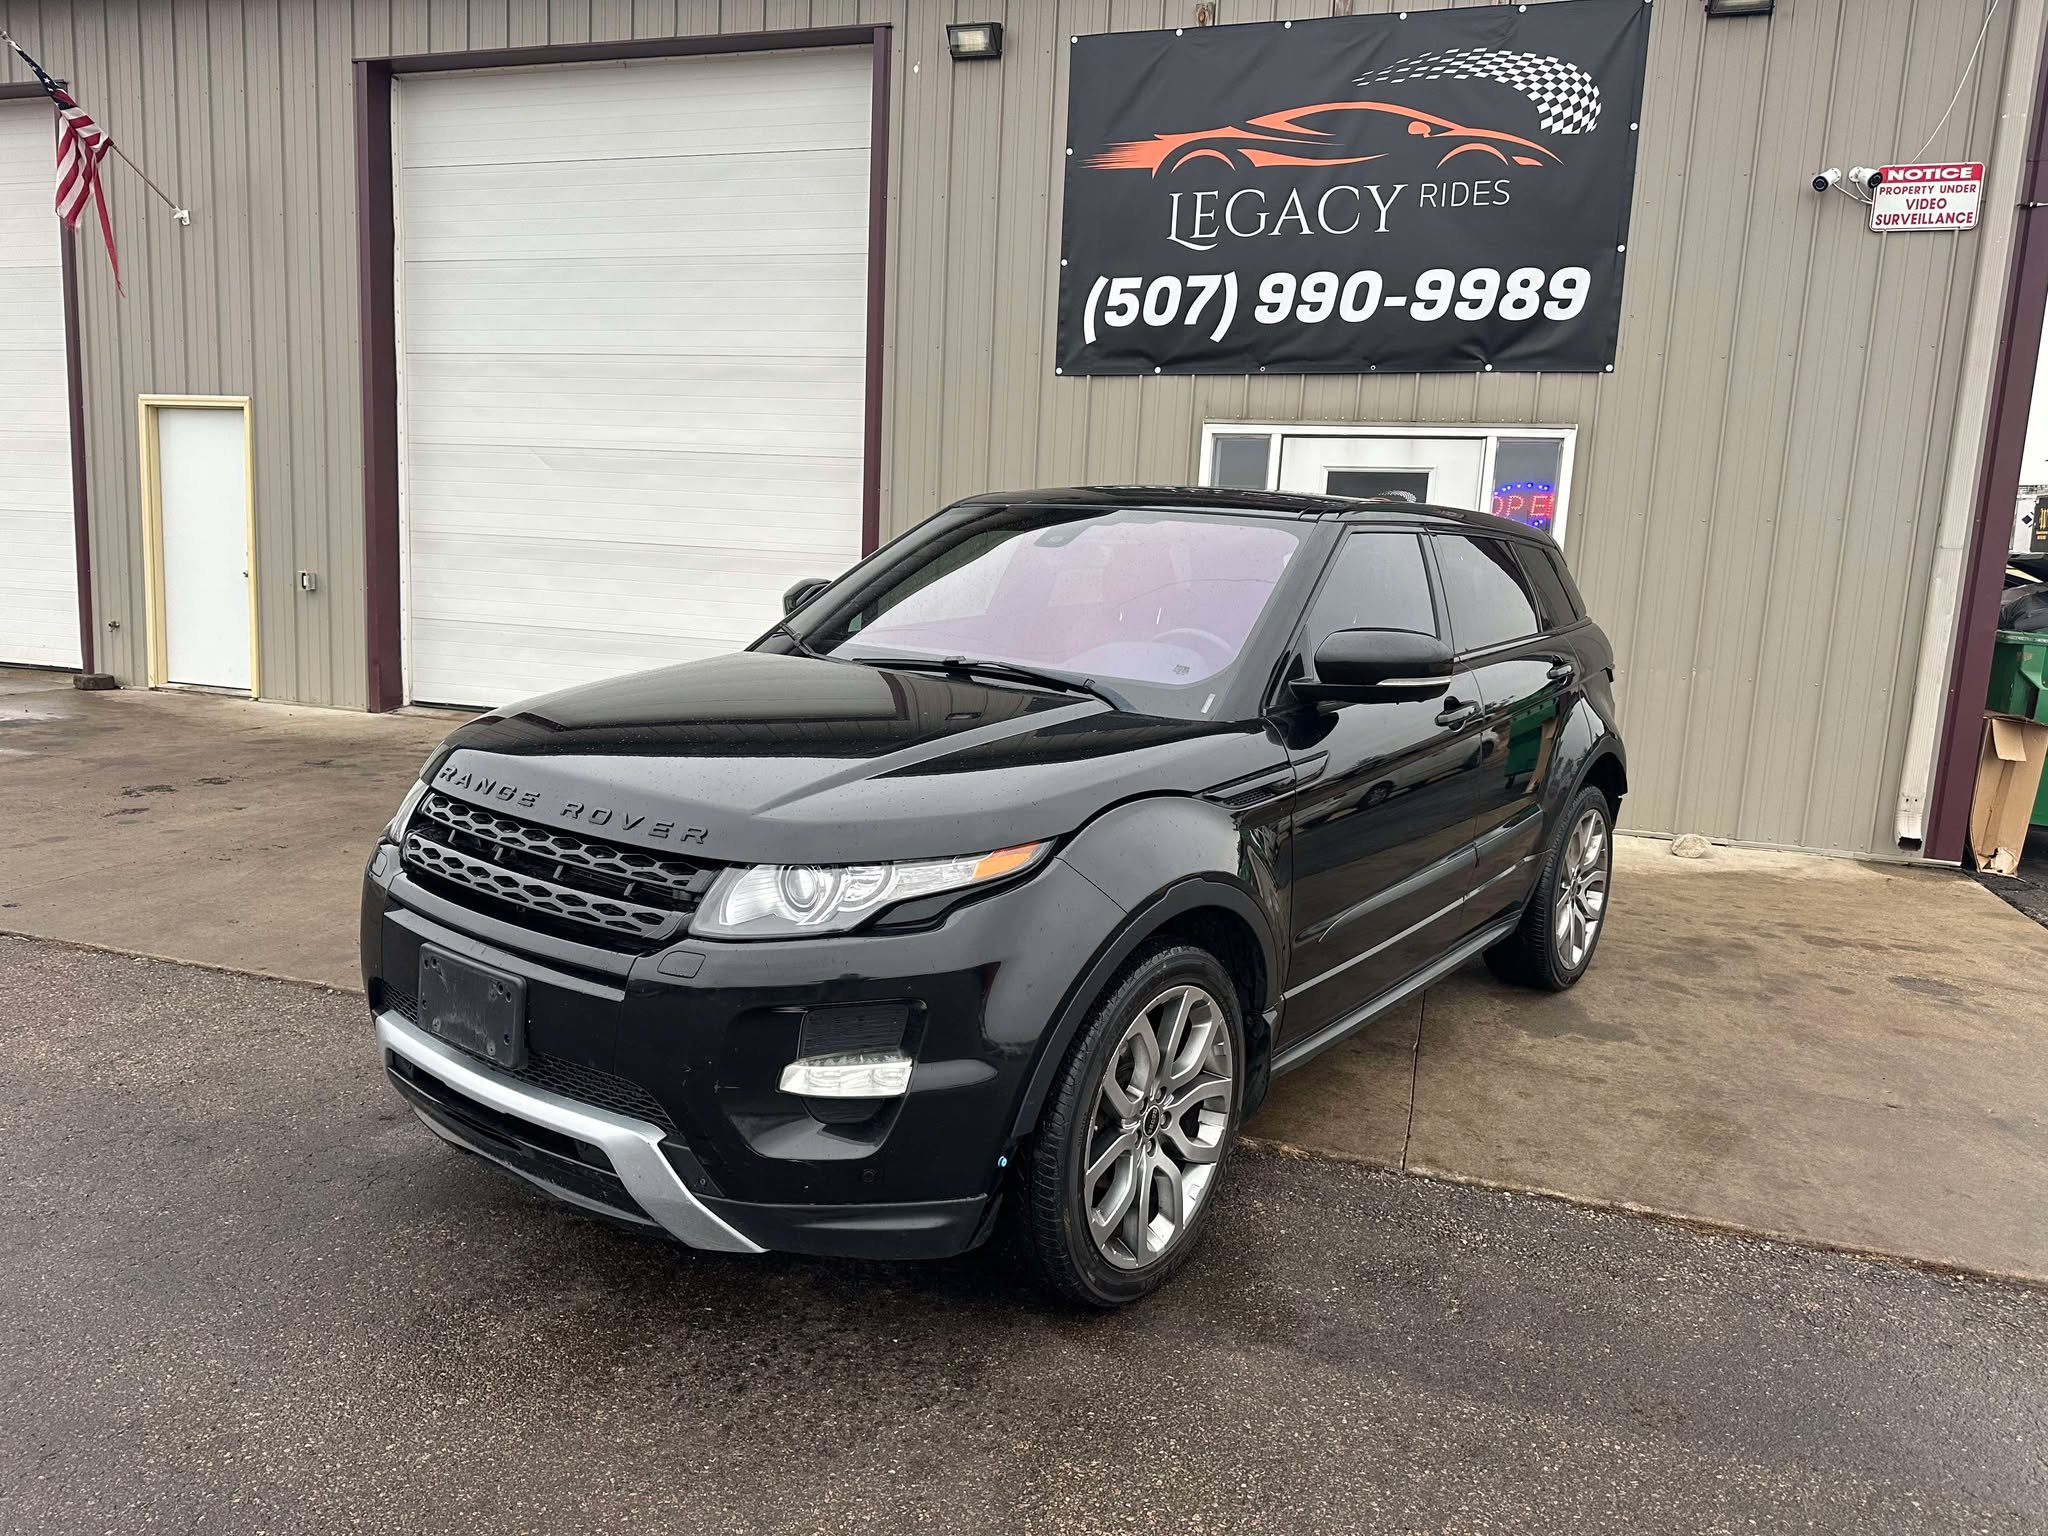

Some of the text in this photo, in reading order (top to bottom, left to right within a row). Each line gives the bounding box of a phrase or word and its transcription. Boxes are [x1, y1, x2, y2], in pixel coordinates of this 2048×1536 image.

[1888, 167, 1972, 180] NOTICE
[1879, 184, 1976, 195] PROPERTY UNDER
[1906, 198, 1947, 209] VIDEO
[1167, 179, 1511, 250] LEGACY RIDES
[1876, 212, 1973, 225] SURVEILLANCE
[1084, 267, 1591, 344] (507) 990-9989
[439, 767, 709, 845] RANGE ROVER
